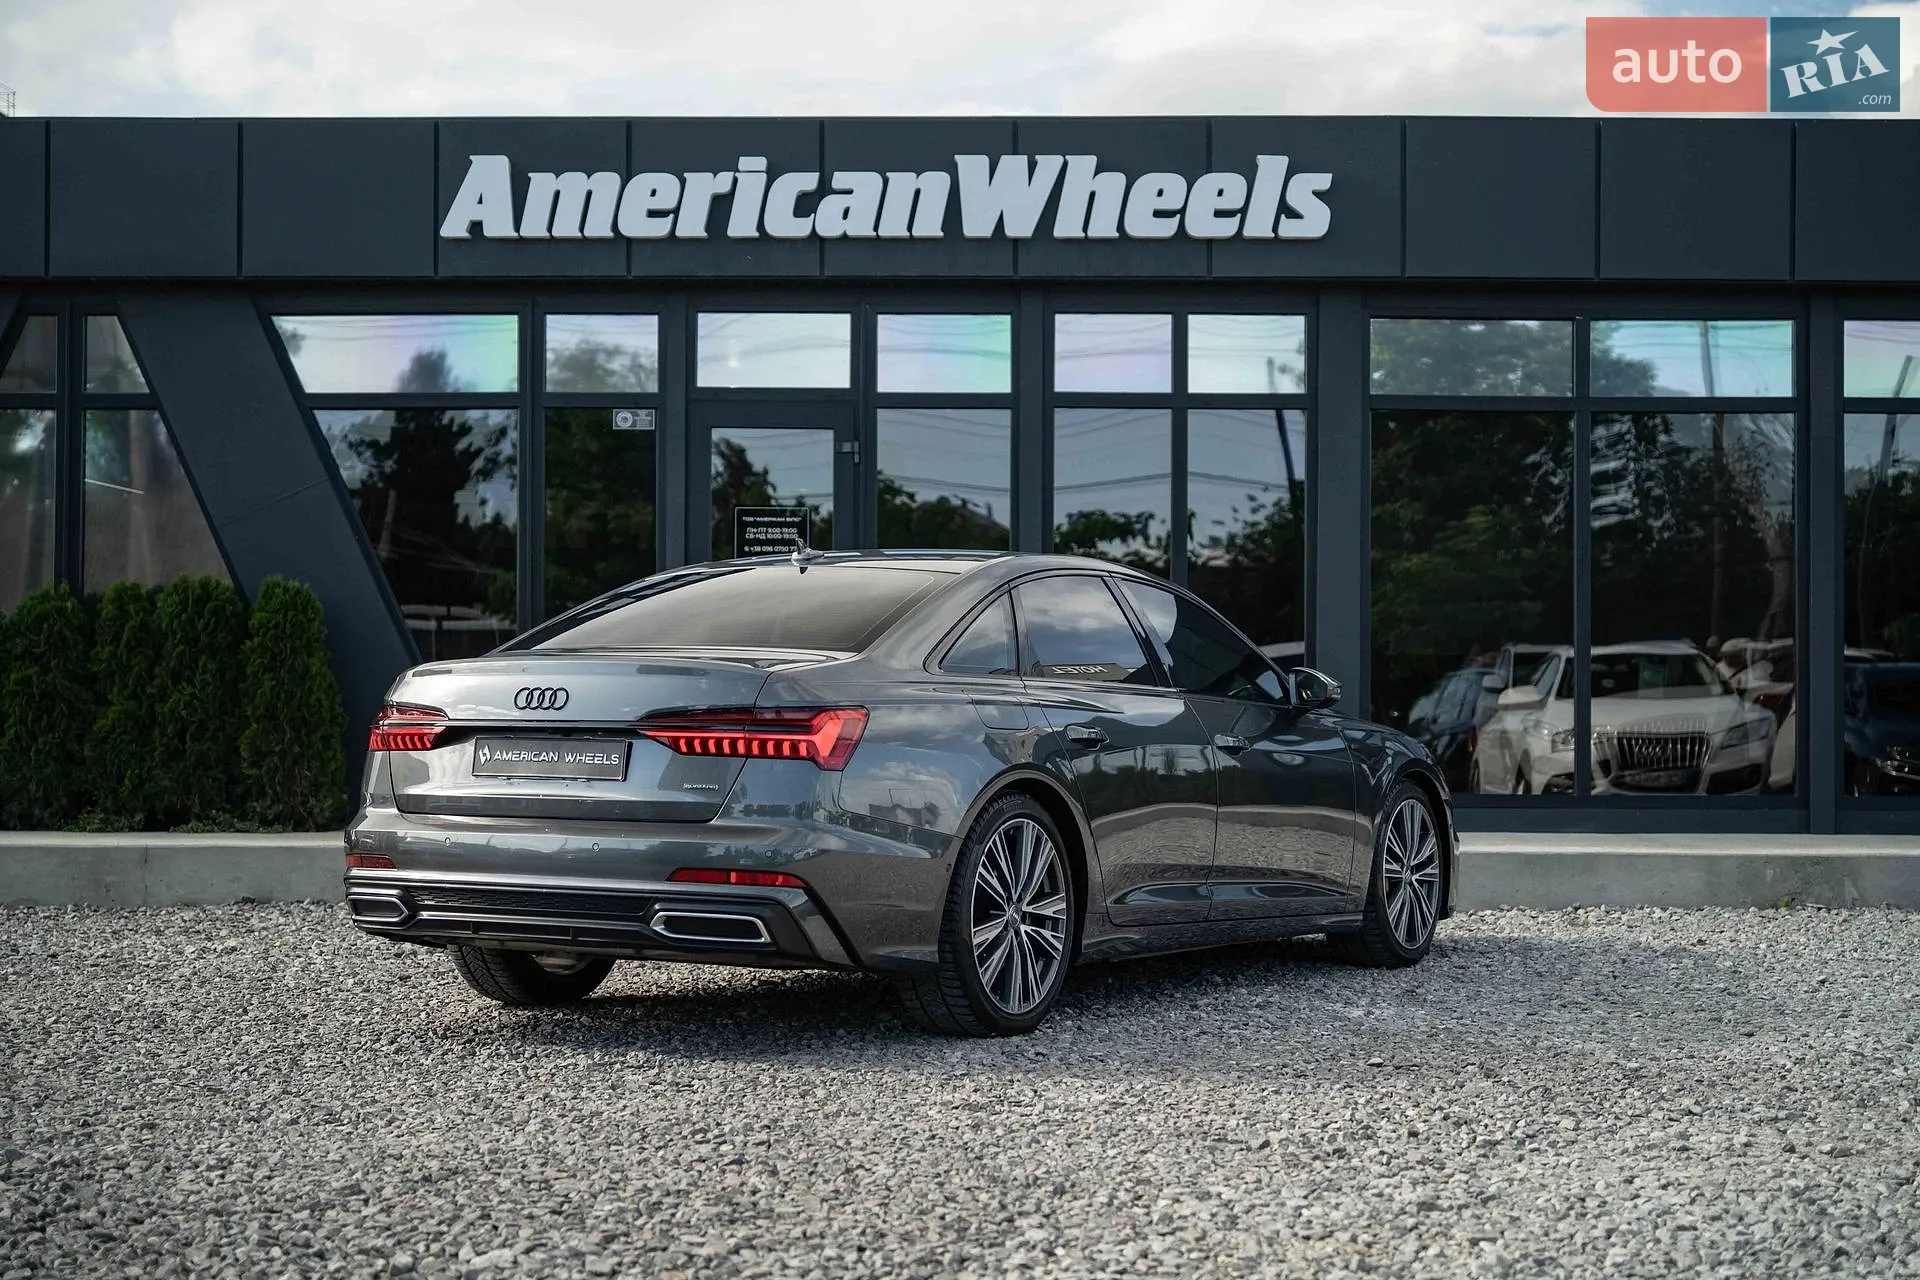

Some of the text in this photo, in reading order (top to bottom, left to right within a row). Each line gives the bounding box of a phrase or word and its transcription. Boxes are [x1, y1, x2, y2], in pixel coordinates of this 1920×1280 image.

[440, 154, 1333, 240] AmericanWheels
[493, 750, 620, 766] AMERICAN WHEELS
